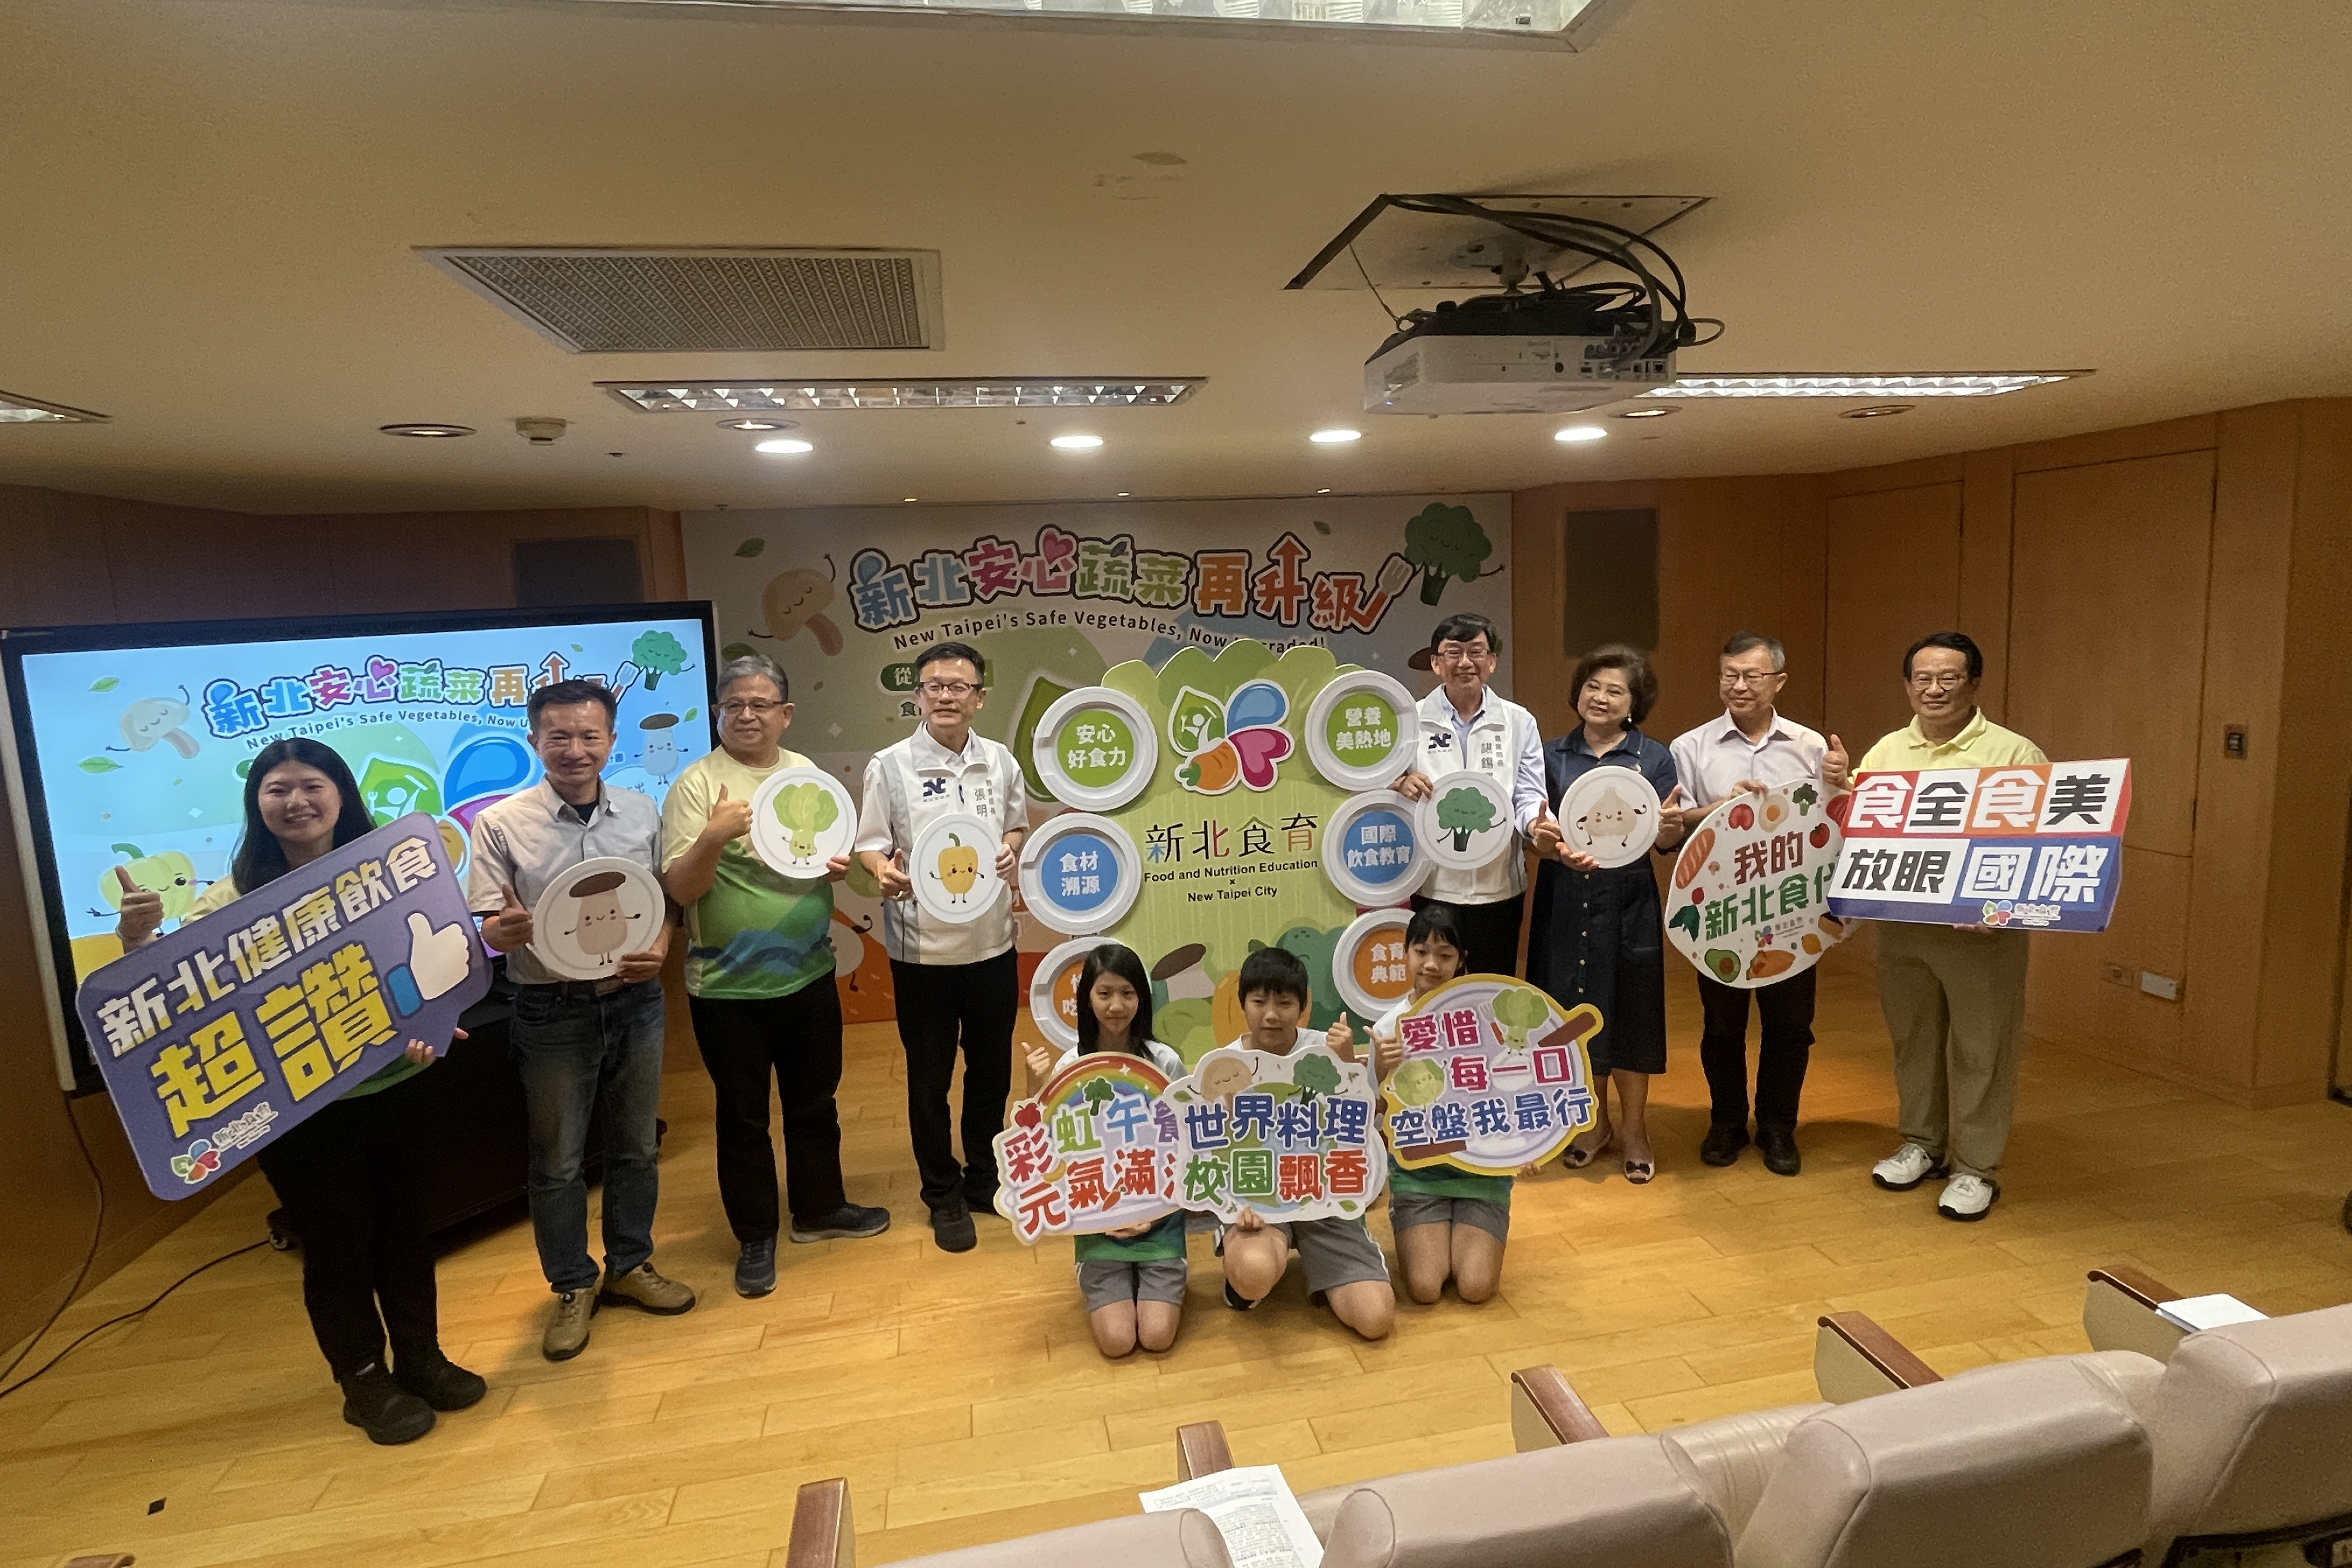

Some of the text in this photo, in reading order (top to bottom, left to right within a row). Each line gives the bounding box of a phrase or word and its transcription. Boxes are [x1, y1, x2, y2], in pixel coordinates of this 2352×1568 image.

[852, 528, 1412, 631] 新北安心蔬菜再升級
[894, 629, 935, 650] New
[941, 614, 1019, 637] Taipei's
[1026, 610, 1066, 625] Safe
[1074, 611, 1182, 641] Vegetables,
[1189, 628, 1227, 648] Now
[246, 731, 283, 750] New
[288, 716, 354, 738] Taipei's
[359, 711, 393, 724] Safe
[398, 709, 482, 725] Vegetables,
[488, 715, 516, 727] Now
[1076, 723, 1116, 745] 安心
[1345, 706, 1381, 727] 營養
[1068, 747, 1126, 769] 好食力
[1848, 769, 2112, 830] 食全食美
[1145, 813, 1318, 863] 新北食育
[1360, 824, 1397, 845] 國際
[1059, 850, 1099, 873] 食材
[1144, 859, 1318, 882] Food and Nutrition Education
[1348, 845, 1411, 868] 飲食教育
[1734, 831, 1804, 885] 我的
[1842, 845, 2110, 903] 放眼國際
[1188, 886, 1278, 902] New Taipei City
[98, 837, 438, 1057] 新北健康飲食
[1371, 942, 1404, 963] 食育
[151, 941, 398, 1139] 超讚
[1401, 1010, 1479, 1052] 愛惜
[1451, 1048, 1571, 1091] 每一口
[1185, 1095, 1368, 1149] 世界料理
[1391, 1087, 1591, 1146] 空盤我最行
[1184, 1149, 1367, 1206] 校園飄香
